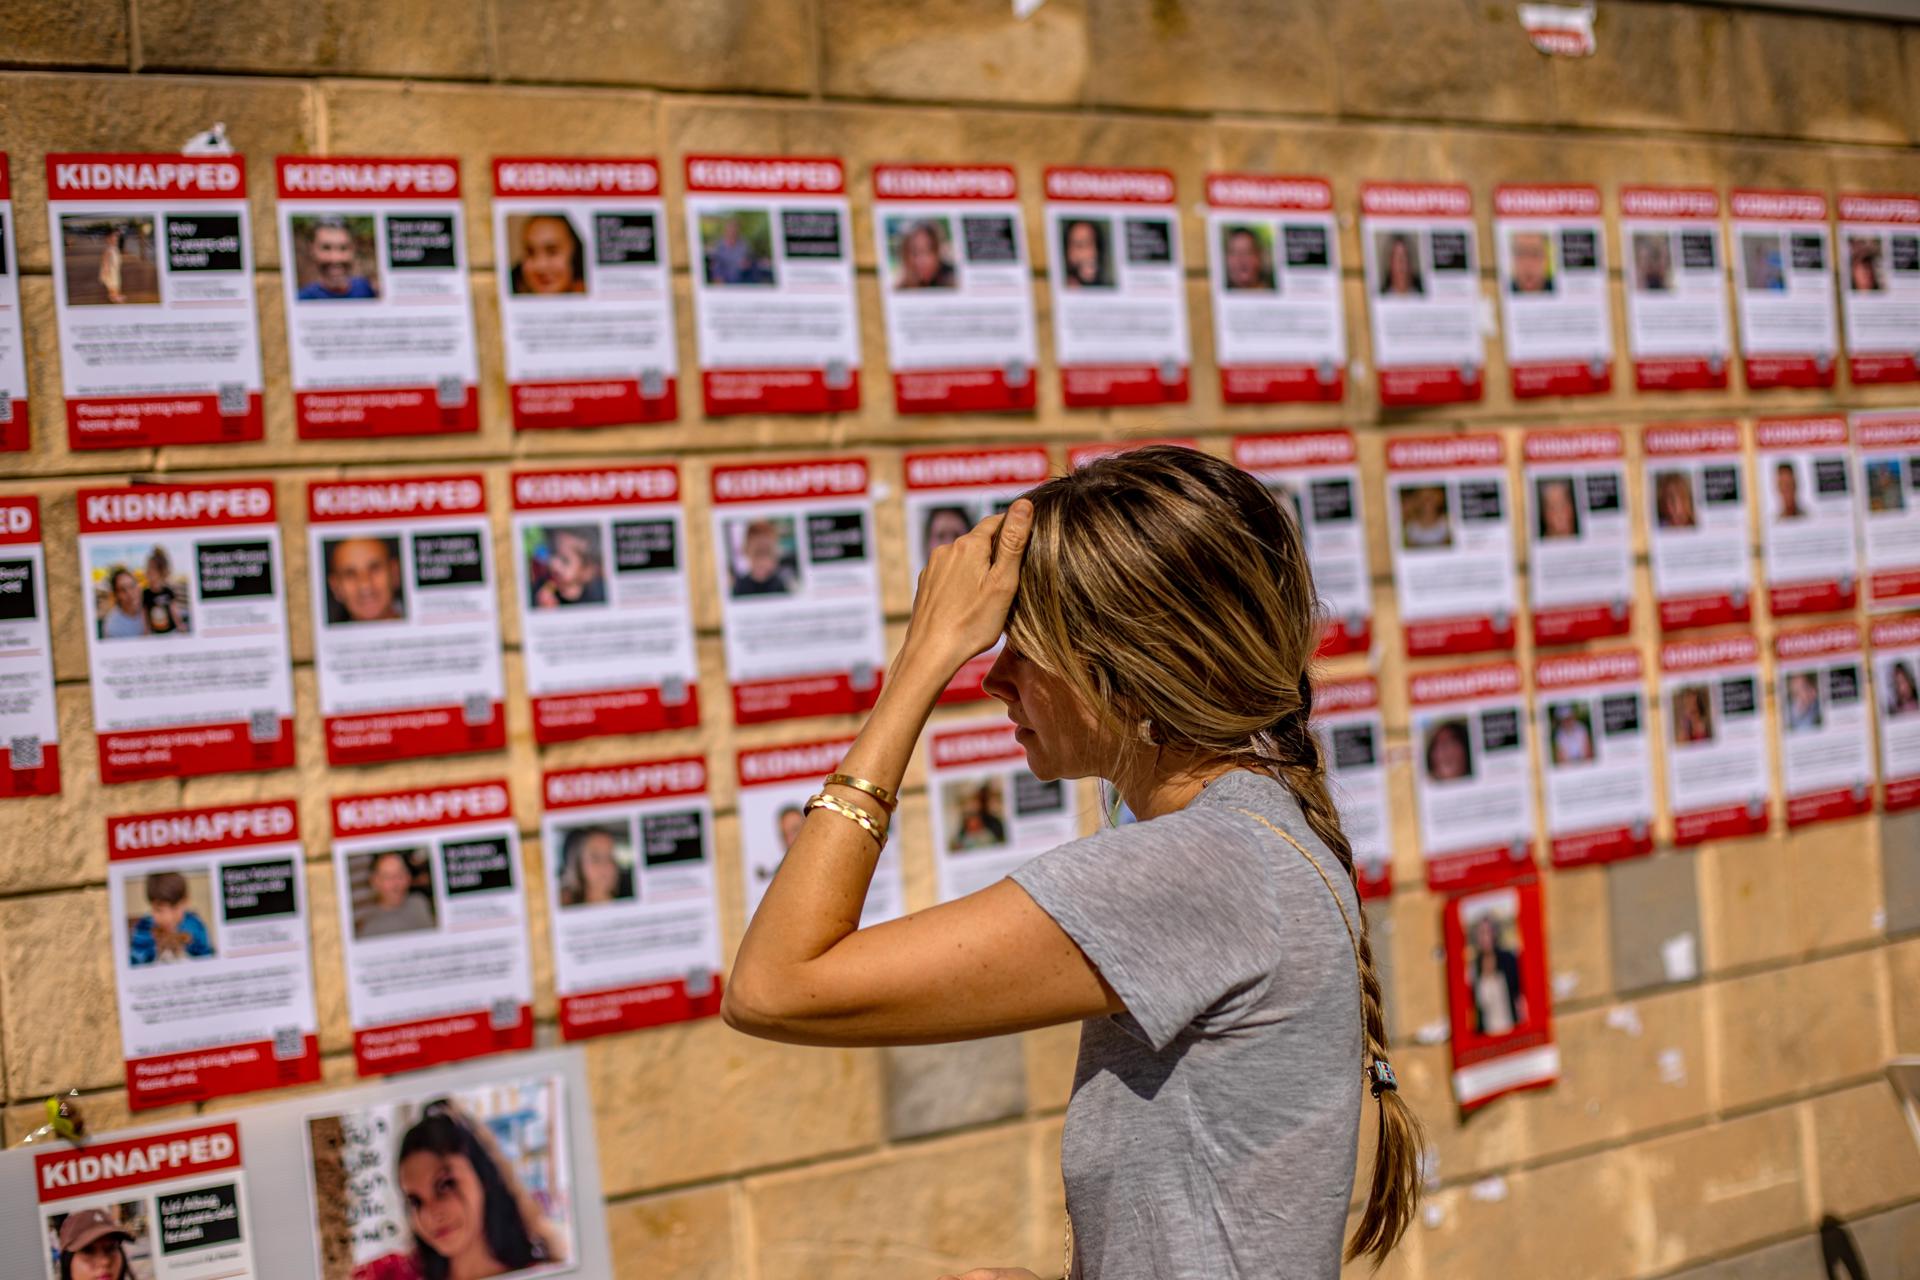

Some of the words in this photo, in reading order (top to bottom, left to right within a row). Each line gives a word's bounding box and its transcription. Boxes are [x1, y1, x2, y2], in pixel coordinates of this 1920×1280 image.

[57, 164, 239, 189] KIDNAPPED
[284, 165, 455, 191] KIDNAPPED
[500, 164, 656, 190] KIDNAPPED
[691, 162, 840, 189] KIDNAPPED
[878, 171, 1014, 195] KIDNAPPED
[1049, 173, 1172, 199] KIDNAPPED
[1211, 181, 1328, 205] KIDNAPPED
[717, 465, 865, 496] KIDNAPPED
[910, 454, 1046, 482] KIDNAPPED
[314, 481, 480, 512] KIDNAPPED
[517, 471, 676, 501] KIDNAPPED
[88, 489, 270, 522] KIDNAPPED
[548, 761, 700, 800] KIDNAPPED
[338, 787, 506, 827] KIDNAPPED
[116, 808, 292, 849] KIDNAPPED
[43, 1133, 234, 1189] KIDNAPPED
